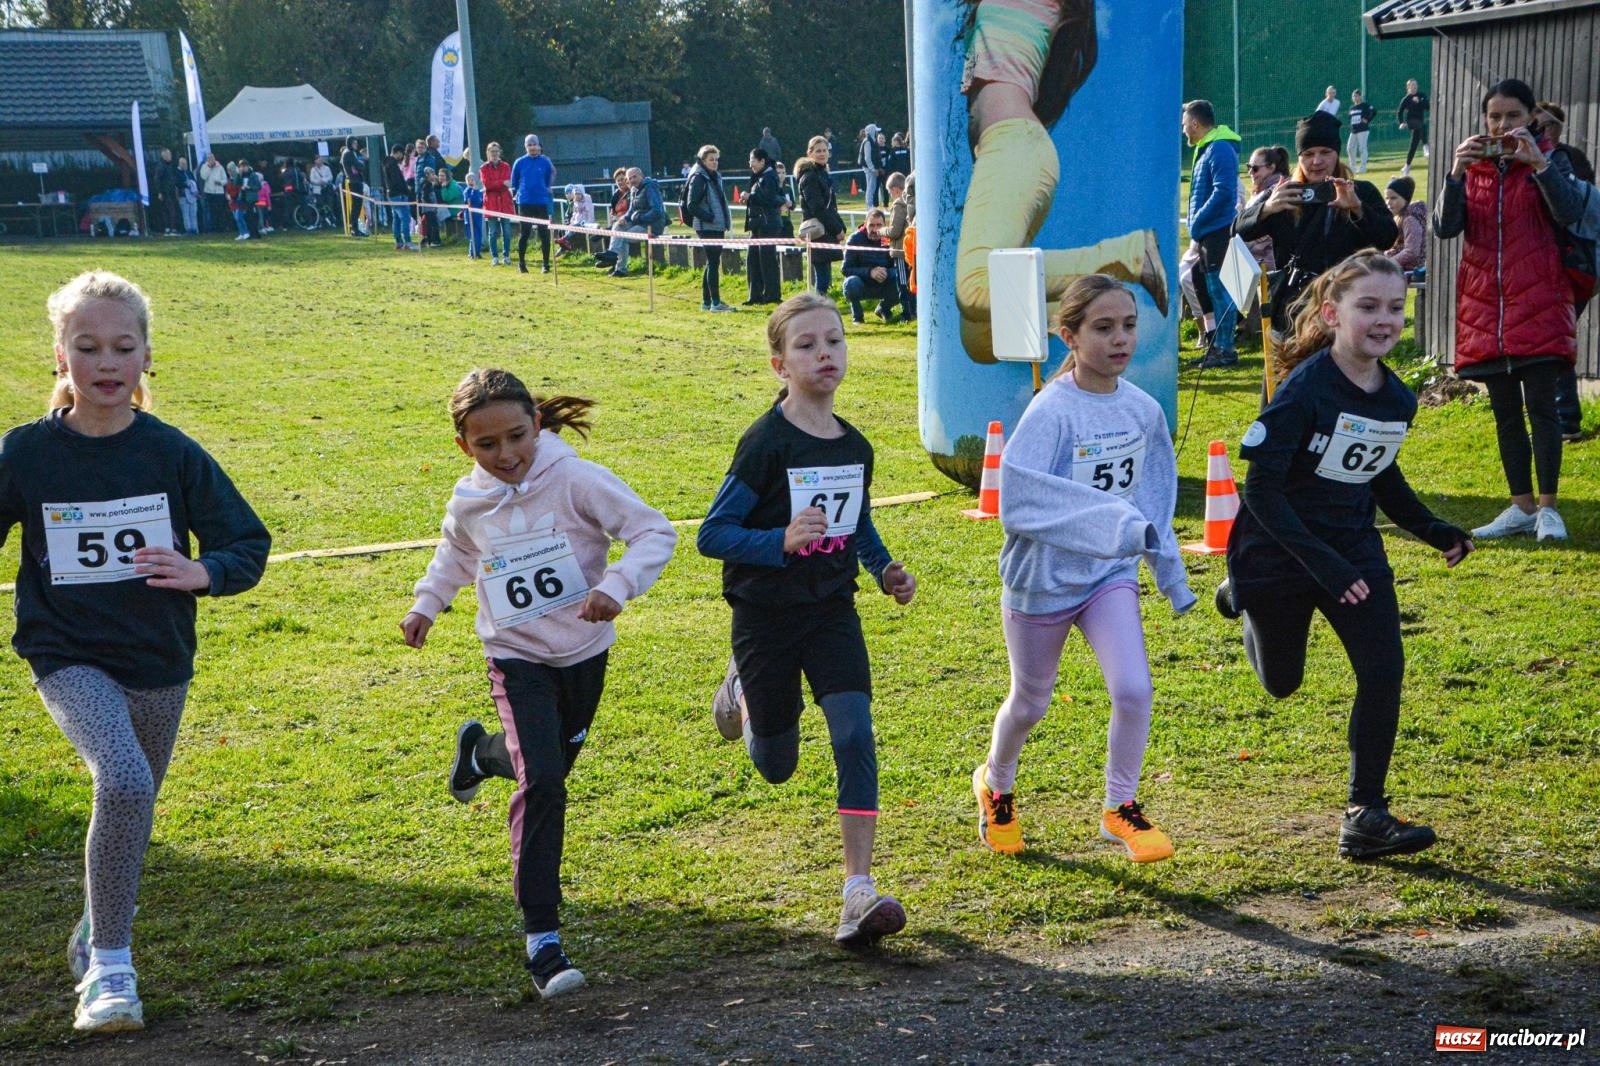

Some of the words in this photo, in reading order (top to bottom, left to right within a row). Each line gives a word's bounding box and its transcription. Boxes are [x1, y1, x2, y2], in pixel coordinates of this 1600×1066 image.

[1342, 442, 1386, 472] 62
[1091, 456, 1134, 492] 53
[89, 502, 164, 518] www.personalbest.pl
[77, 528, 147, 568] 59
[509, 541, 567, 563] www.personalbest.pl
[506, 567, 564, 610] 66
